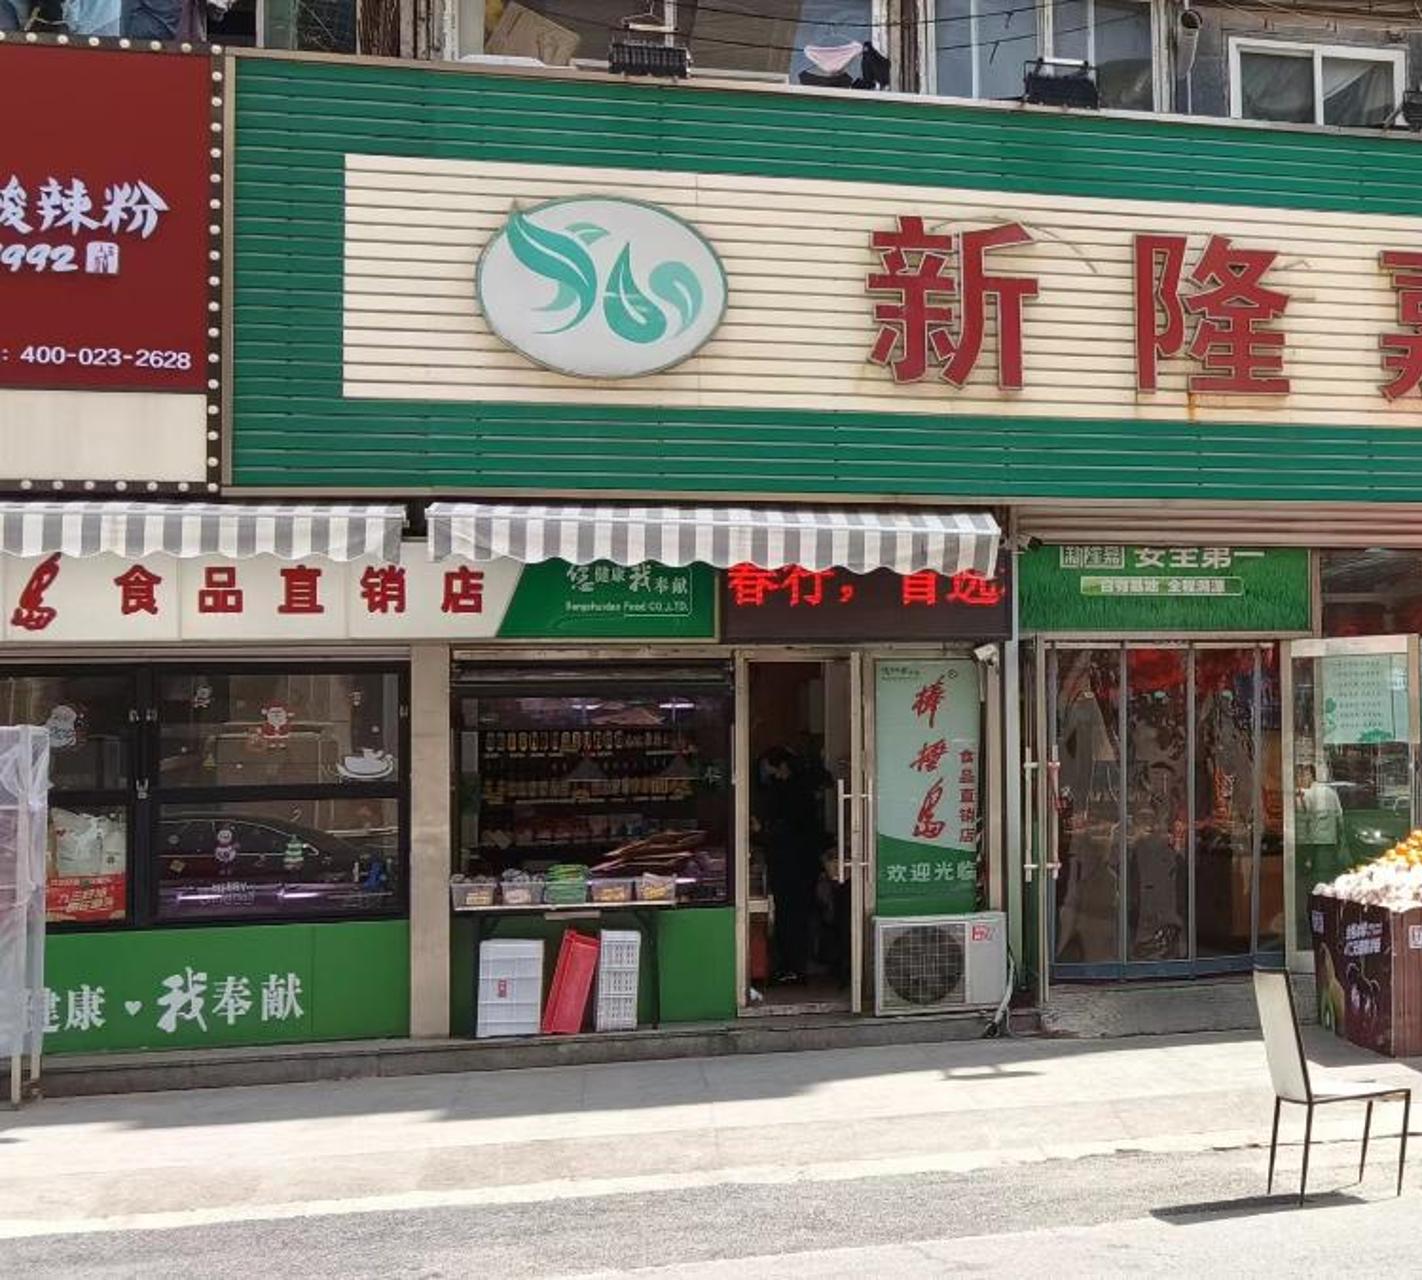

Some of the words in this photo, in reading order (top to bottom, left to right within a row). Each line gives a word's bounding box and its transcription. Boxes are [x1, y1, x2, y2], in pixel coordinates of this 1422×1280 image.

[0, 242, 78, 272] 992
[20, 346, 192, 370] 400-023-2628
[114, 564, 486, 615] 食品直销店
[886, 860, 978, 883] 欢迎光临
[156, 966, 304, 1033] 我奉献
